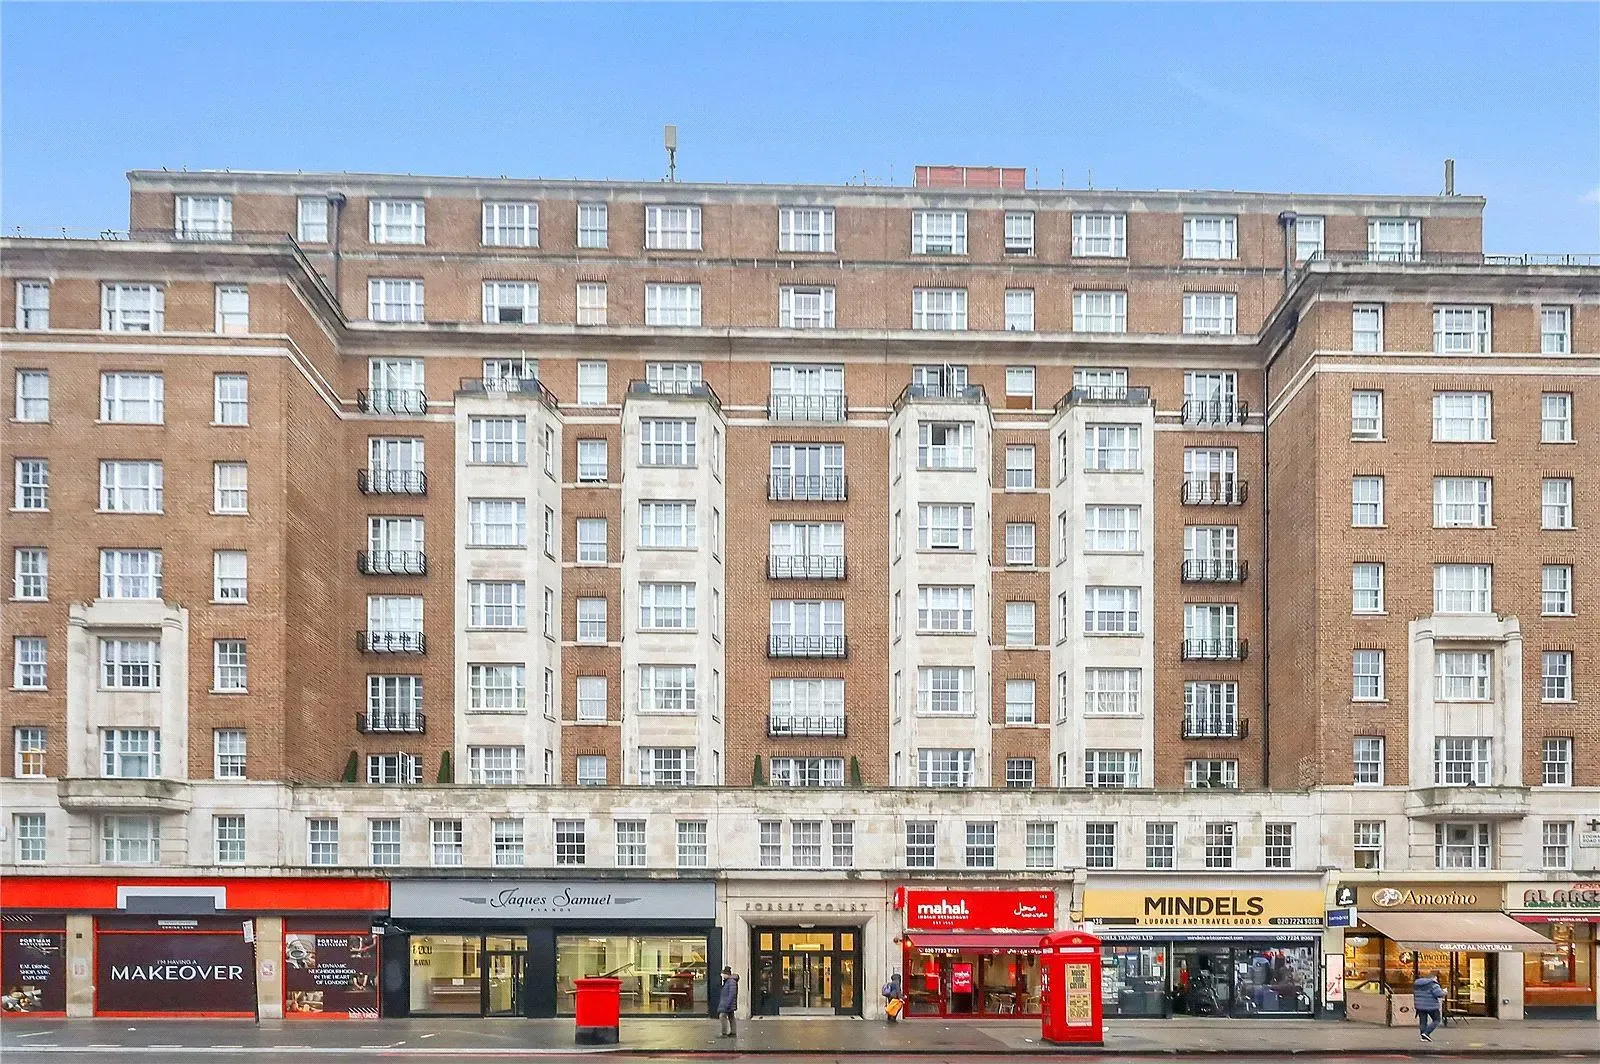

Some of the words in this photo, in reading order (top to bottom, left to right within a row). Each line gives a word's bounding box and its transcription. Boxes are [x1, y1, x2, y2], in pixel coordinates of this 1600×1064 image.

[490, 887, 546, 908] Jaques
[552, 887, 611, 907] Samuel
[1402, 890, 1477, 905] Amorino
[1524, 889, 1550, 902] AL
[917, 899, 969, 914] mahal.
[1145, 897, 1264, 916] MINDELS
[111, 966, 242, 980] MAKEOVER
